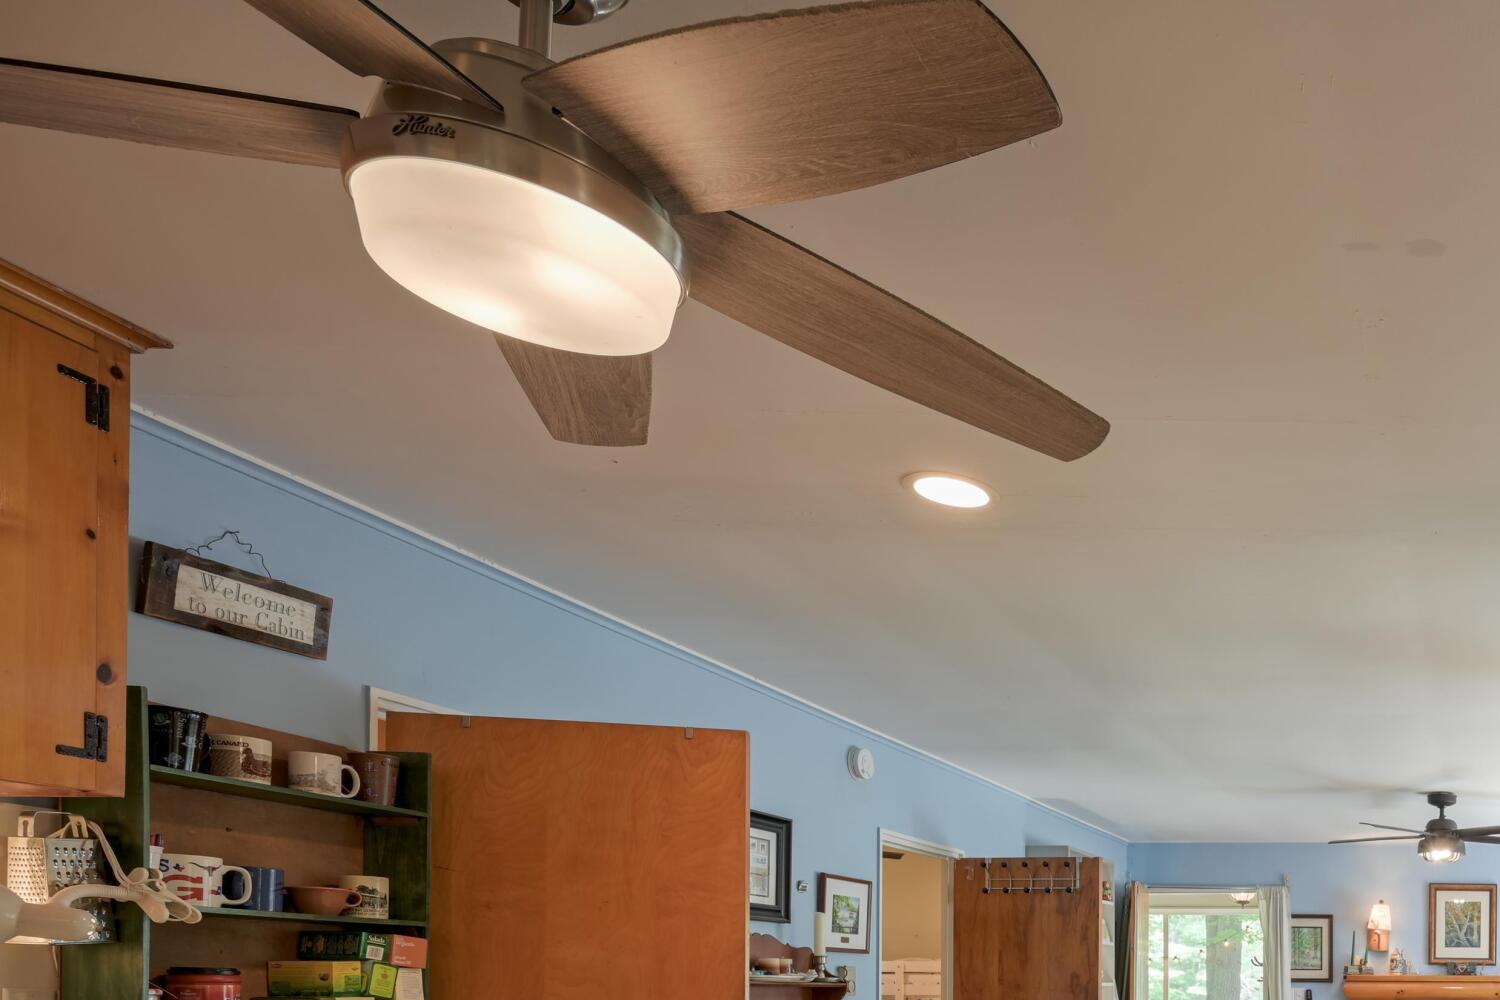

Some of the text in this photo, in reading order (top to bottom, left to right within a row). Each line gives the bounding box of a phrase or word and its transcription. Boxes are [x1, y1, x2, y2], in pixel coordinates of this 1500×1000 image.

[392, 113, 456, 139] Hunter
[200, 572, 296, 617] Welcome
[188, 596, 305, 641] to our Cabin
